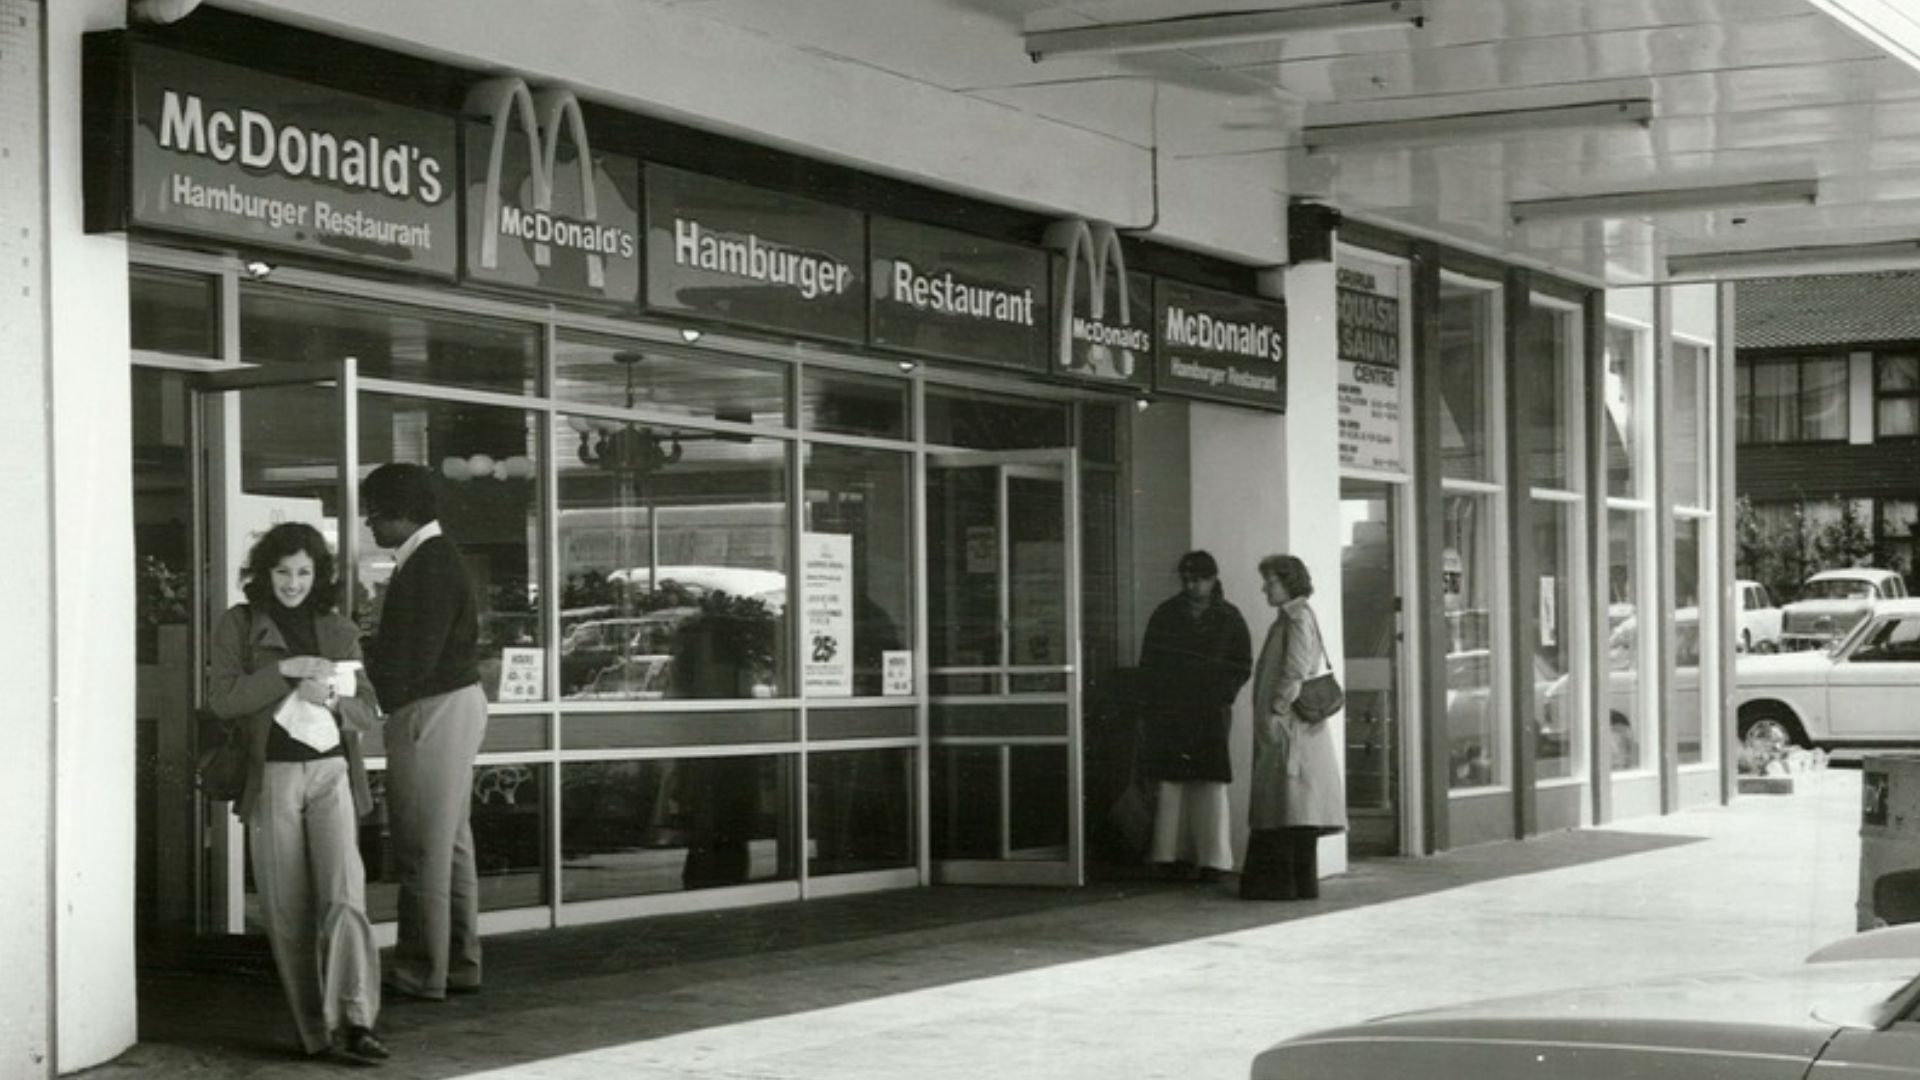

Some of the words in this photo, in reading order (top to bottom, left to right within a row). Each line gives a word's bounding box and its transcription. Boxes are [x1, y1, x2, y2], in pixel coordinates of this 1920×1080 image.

[160, 91, 442, 203] McDonald's
[173, 174, 307, 228] Hamburger
[314, 201, 432, 249] Restaurant
[501, 207, 634, 258] McDonald's
[675, 219, 849, 299] Hamburger
[893, 260, 1034, 326] Restaurant
[1073, 318, 1150, 352] McDonald's
[1167, 307, 1283, 363] McDonald's
[1342, 325, 1397, 363] SAUNA
[1170, 357, 1225, 386] Hamburger
[1353, 364, 1396, 388] CENTRE
